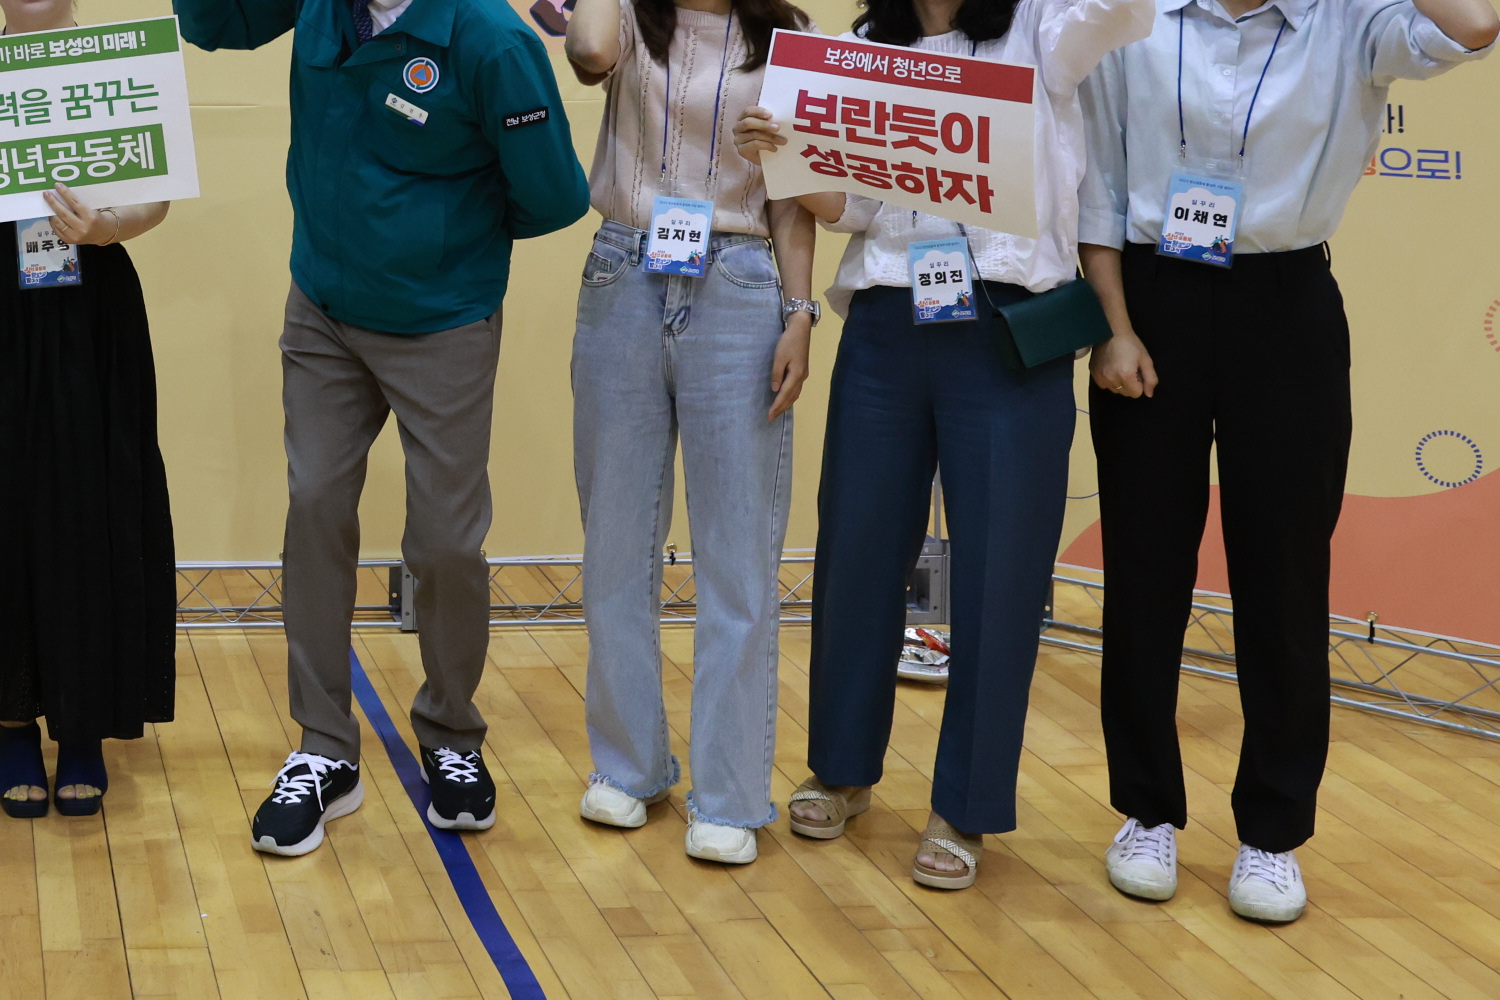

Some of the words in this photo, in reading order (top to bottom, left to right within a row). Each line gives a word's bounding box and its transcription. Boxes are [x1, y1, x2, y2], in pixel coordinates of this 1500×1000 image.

[14, 43, 47, 63] 바로
[49, 35, 101, 57] 보성의
[824, 47, 890, 75] 보성에서
[892, 57, 962, 85] 청년으로
[60, 77, 159, 121] 꿈꾸는
[792, 88, 991, 164] 보란듯이
[799, 143, 995, 214] 성공하자
[1174, 206, 1228, 228] 이채연
[918, 269, 963, 286] 정의진
